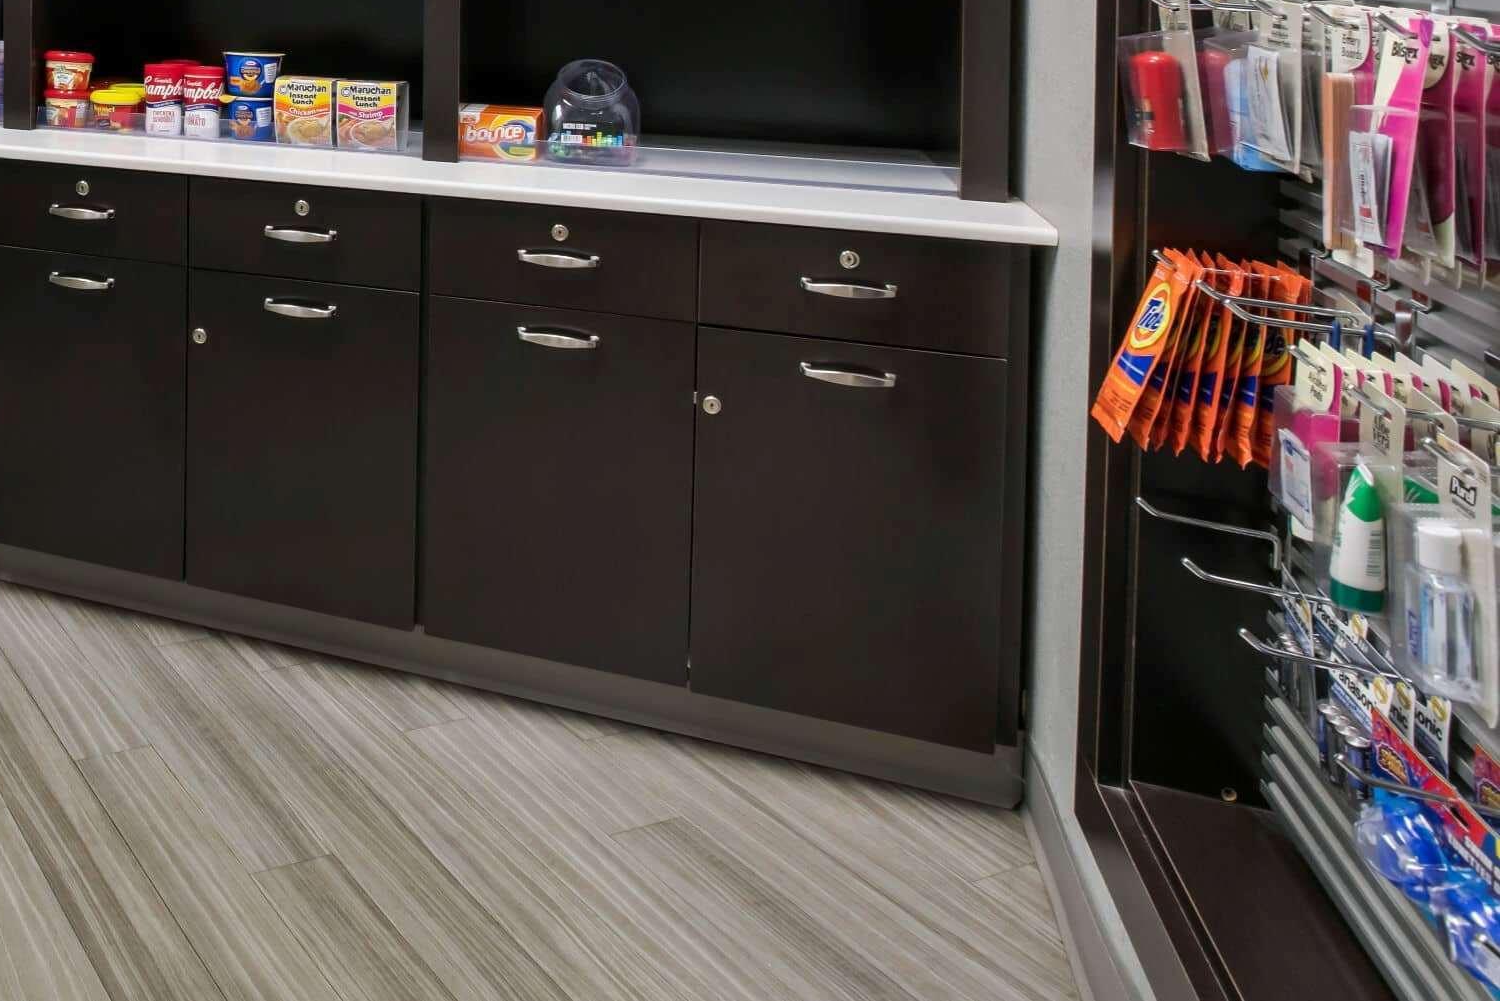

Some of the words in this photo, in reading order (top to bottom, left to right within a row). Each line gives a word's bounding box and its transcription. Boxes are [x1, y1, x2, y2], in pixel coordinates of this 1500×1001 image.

[287, 83, 327, 94] Maruchan
[349, 86, 392, 96] Maruchan
[292, 98, 314, 106] Lunch
[358, 111, 384, 120] Shrimp
[466, 123, 526, 144] bounce
[1137, 298, 1165, 333] Tide
[1450, 476, 1477, 506] Purell
